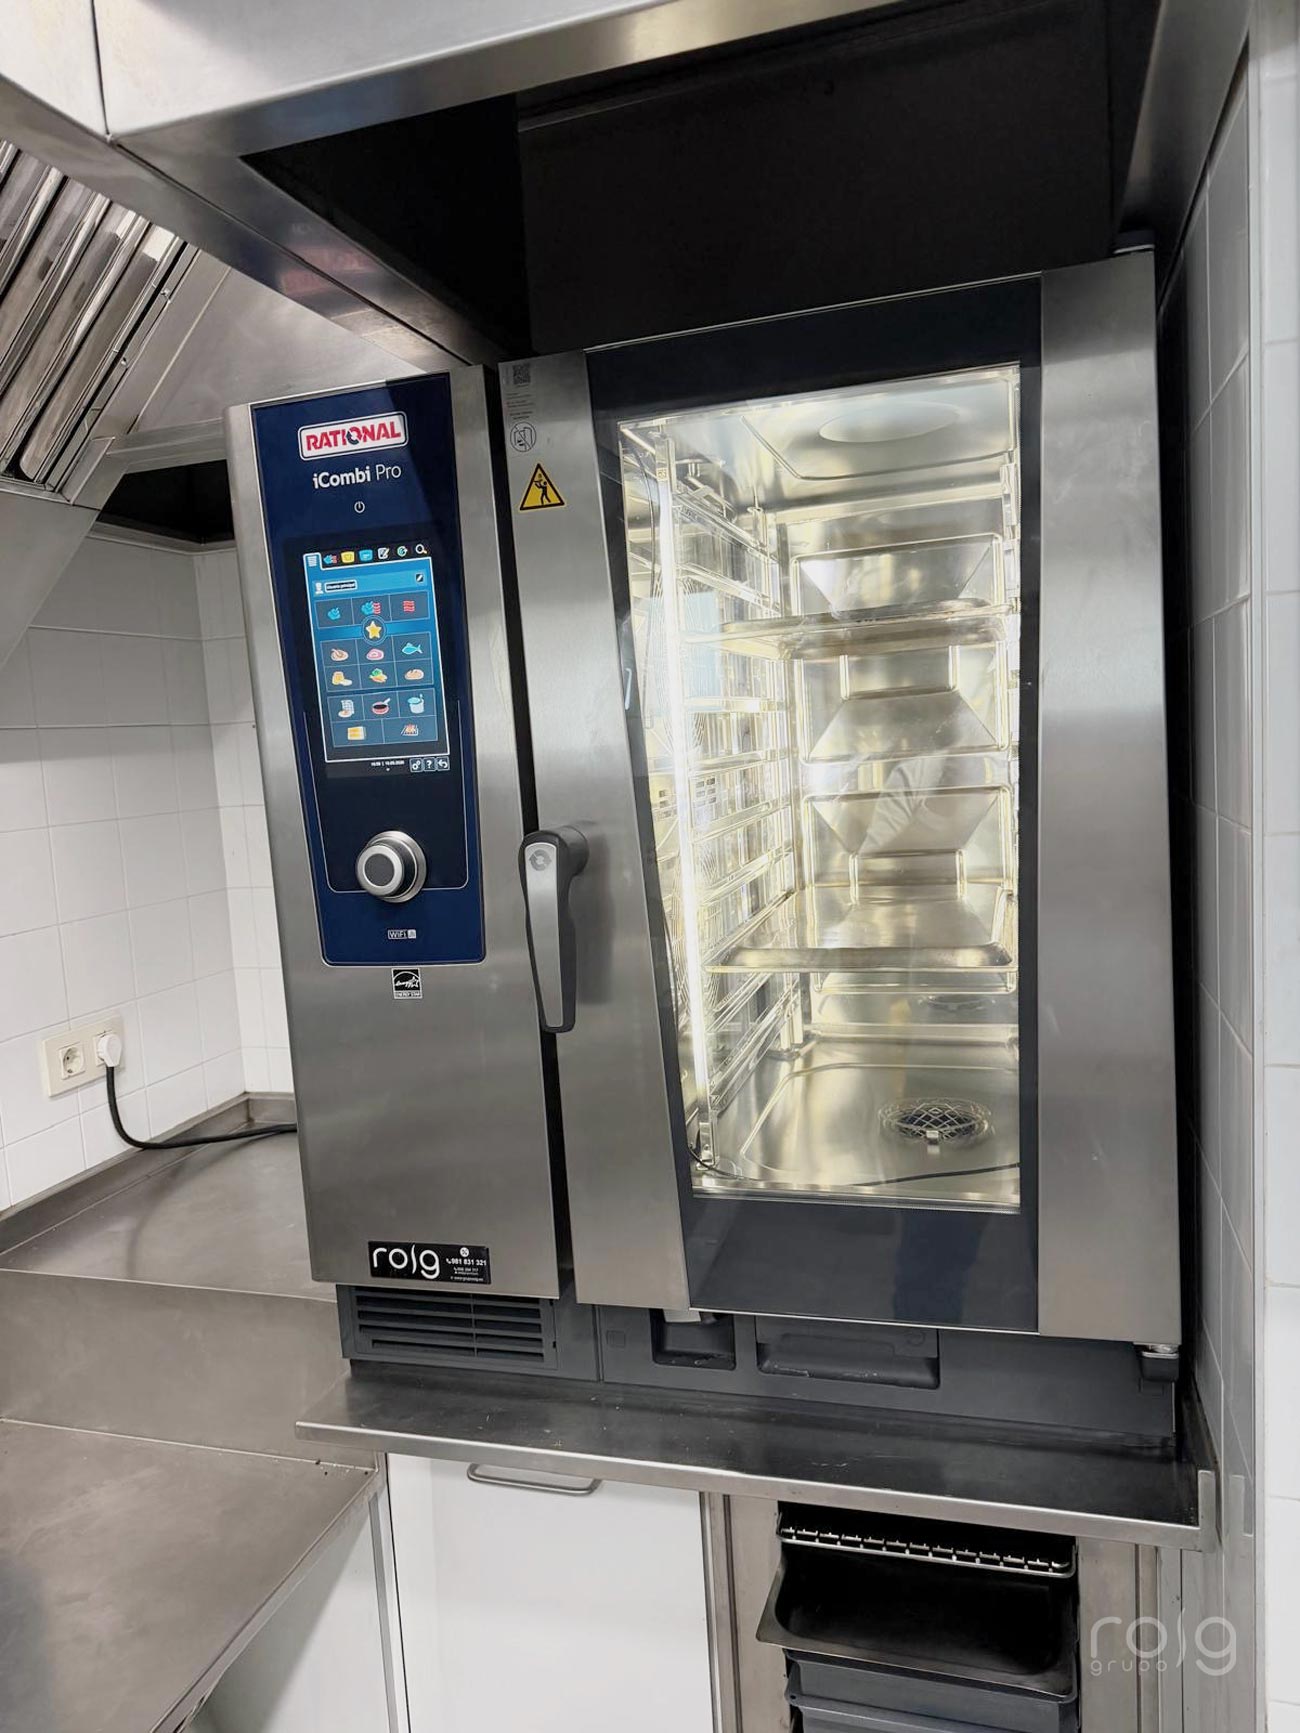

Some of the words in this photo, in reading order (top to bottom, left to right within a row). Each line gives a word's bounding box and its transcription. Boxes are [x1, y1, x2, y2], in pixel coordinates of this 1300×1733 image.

[305, 421, 401, 452] RATIONAL
[312, 465, 371, 489] iCombi
[375, 463, 402, 480] Pro
